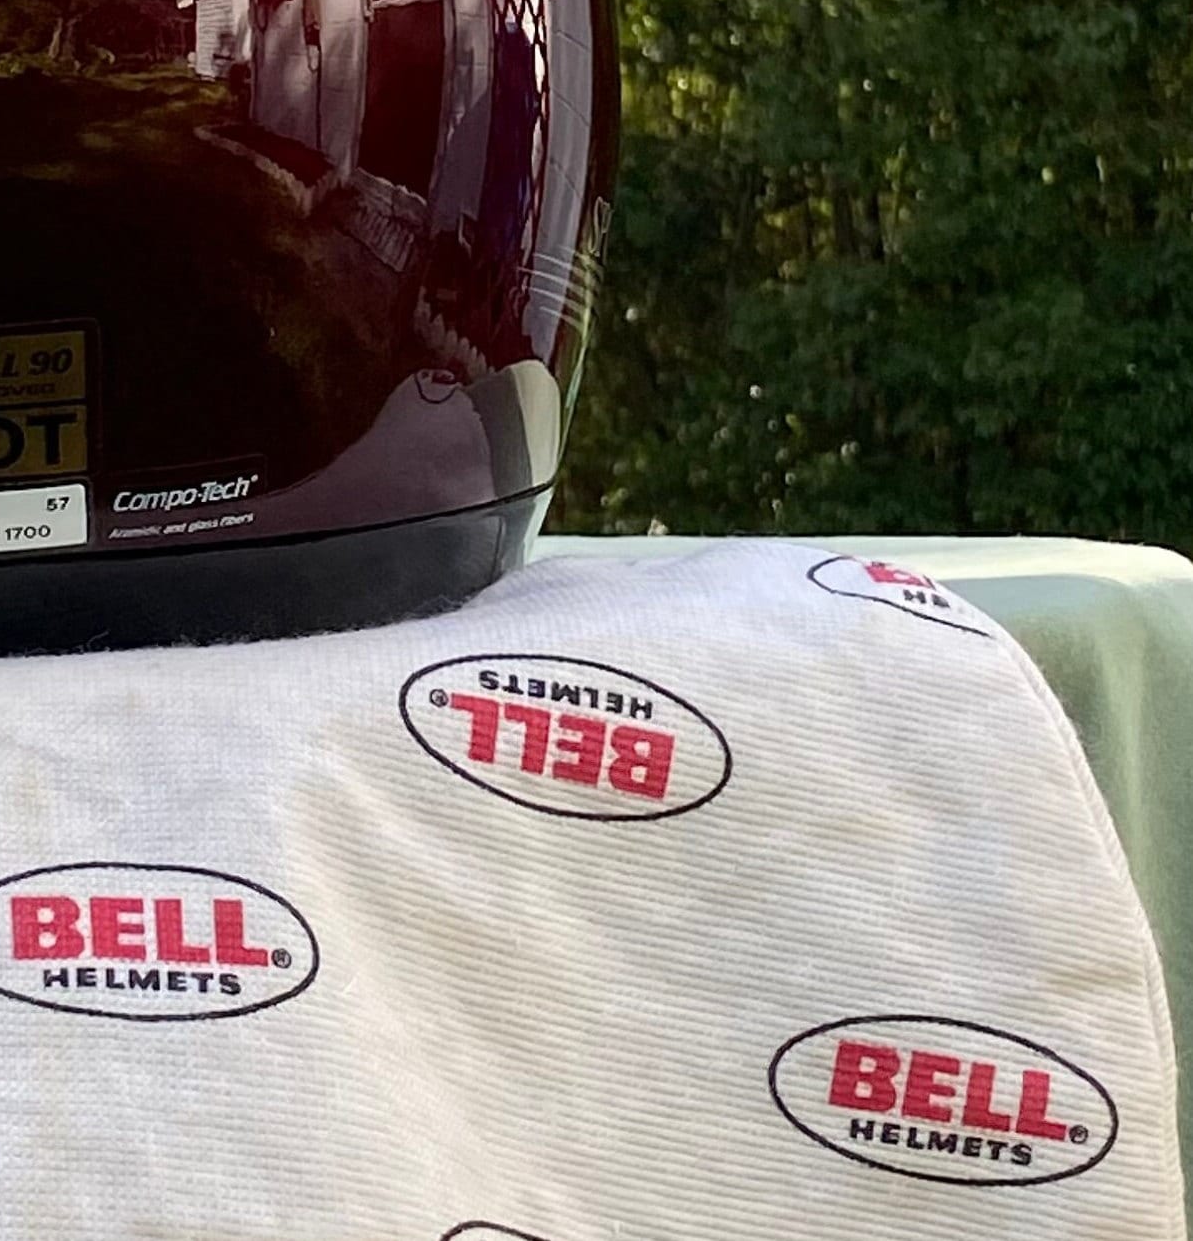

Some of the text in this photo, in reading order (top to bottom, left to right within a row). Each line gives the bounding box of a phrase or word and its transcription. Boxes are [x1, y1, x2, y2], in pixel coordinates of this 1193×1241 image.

[29, 347, 73, 376] 90
[45, 496, 70, 512] 57
[4, 524, 52, 541] 1700
[478, 669, 653, 720] HELMETS
[449, 692, 676, 801] BELL
[10, 896, 270, 968] BELL
[43, 966, 242, 996] HELMETS
[827, 1038, 1068, 1143] BELL
[849, 1118, 1034, 1167] HELMETS
